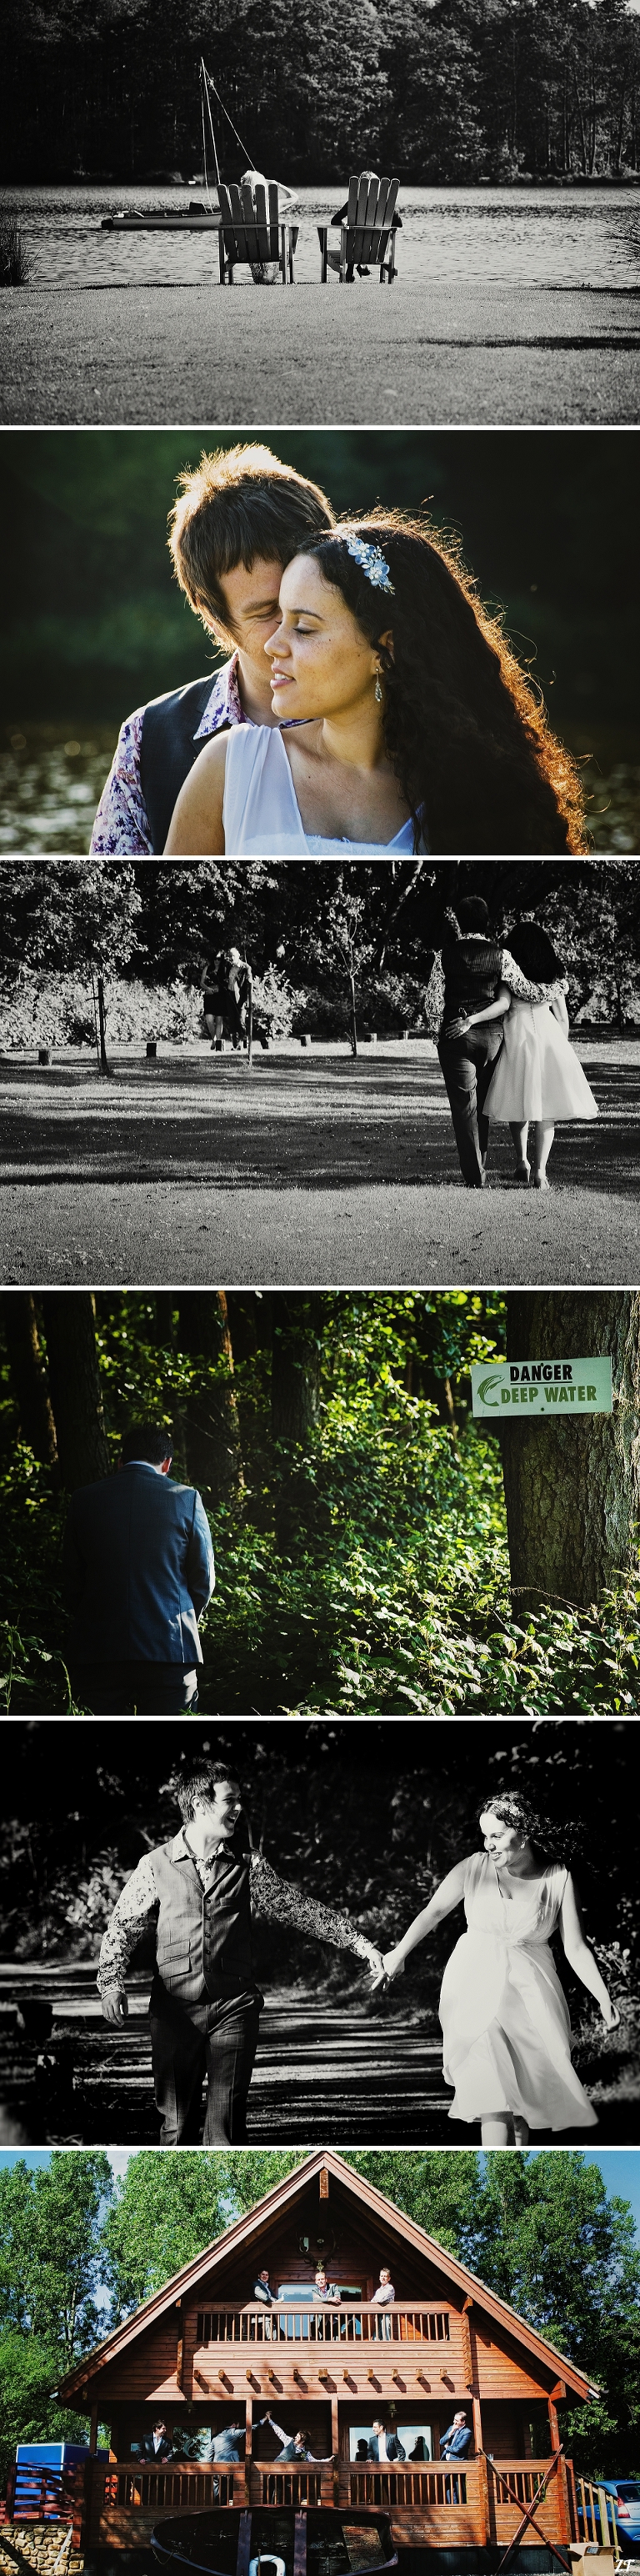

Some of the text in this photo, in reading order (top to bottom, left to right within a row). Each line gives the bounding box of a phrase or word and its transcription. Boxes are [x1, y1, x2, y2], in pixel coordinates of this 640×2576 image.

[510, 1365, 572, 1381] DANGER
[501, 1386, 597, 1404] DEEP WATER
